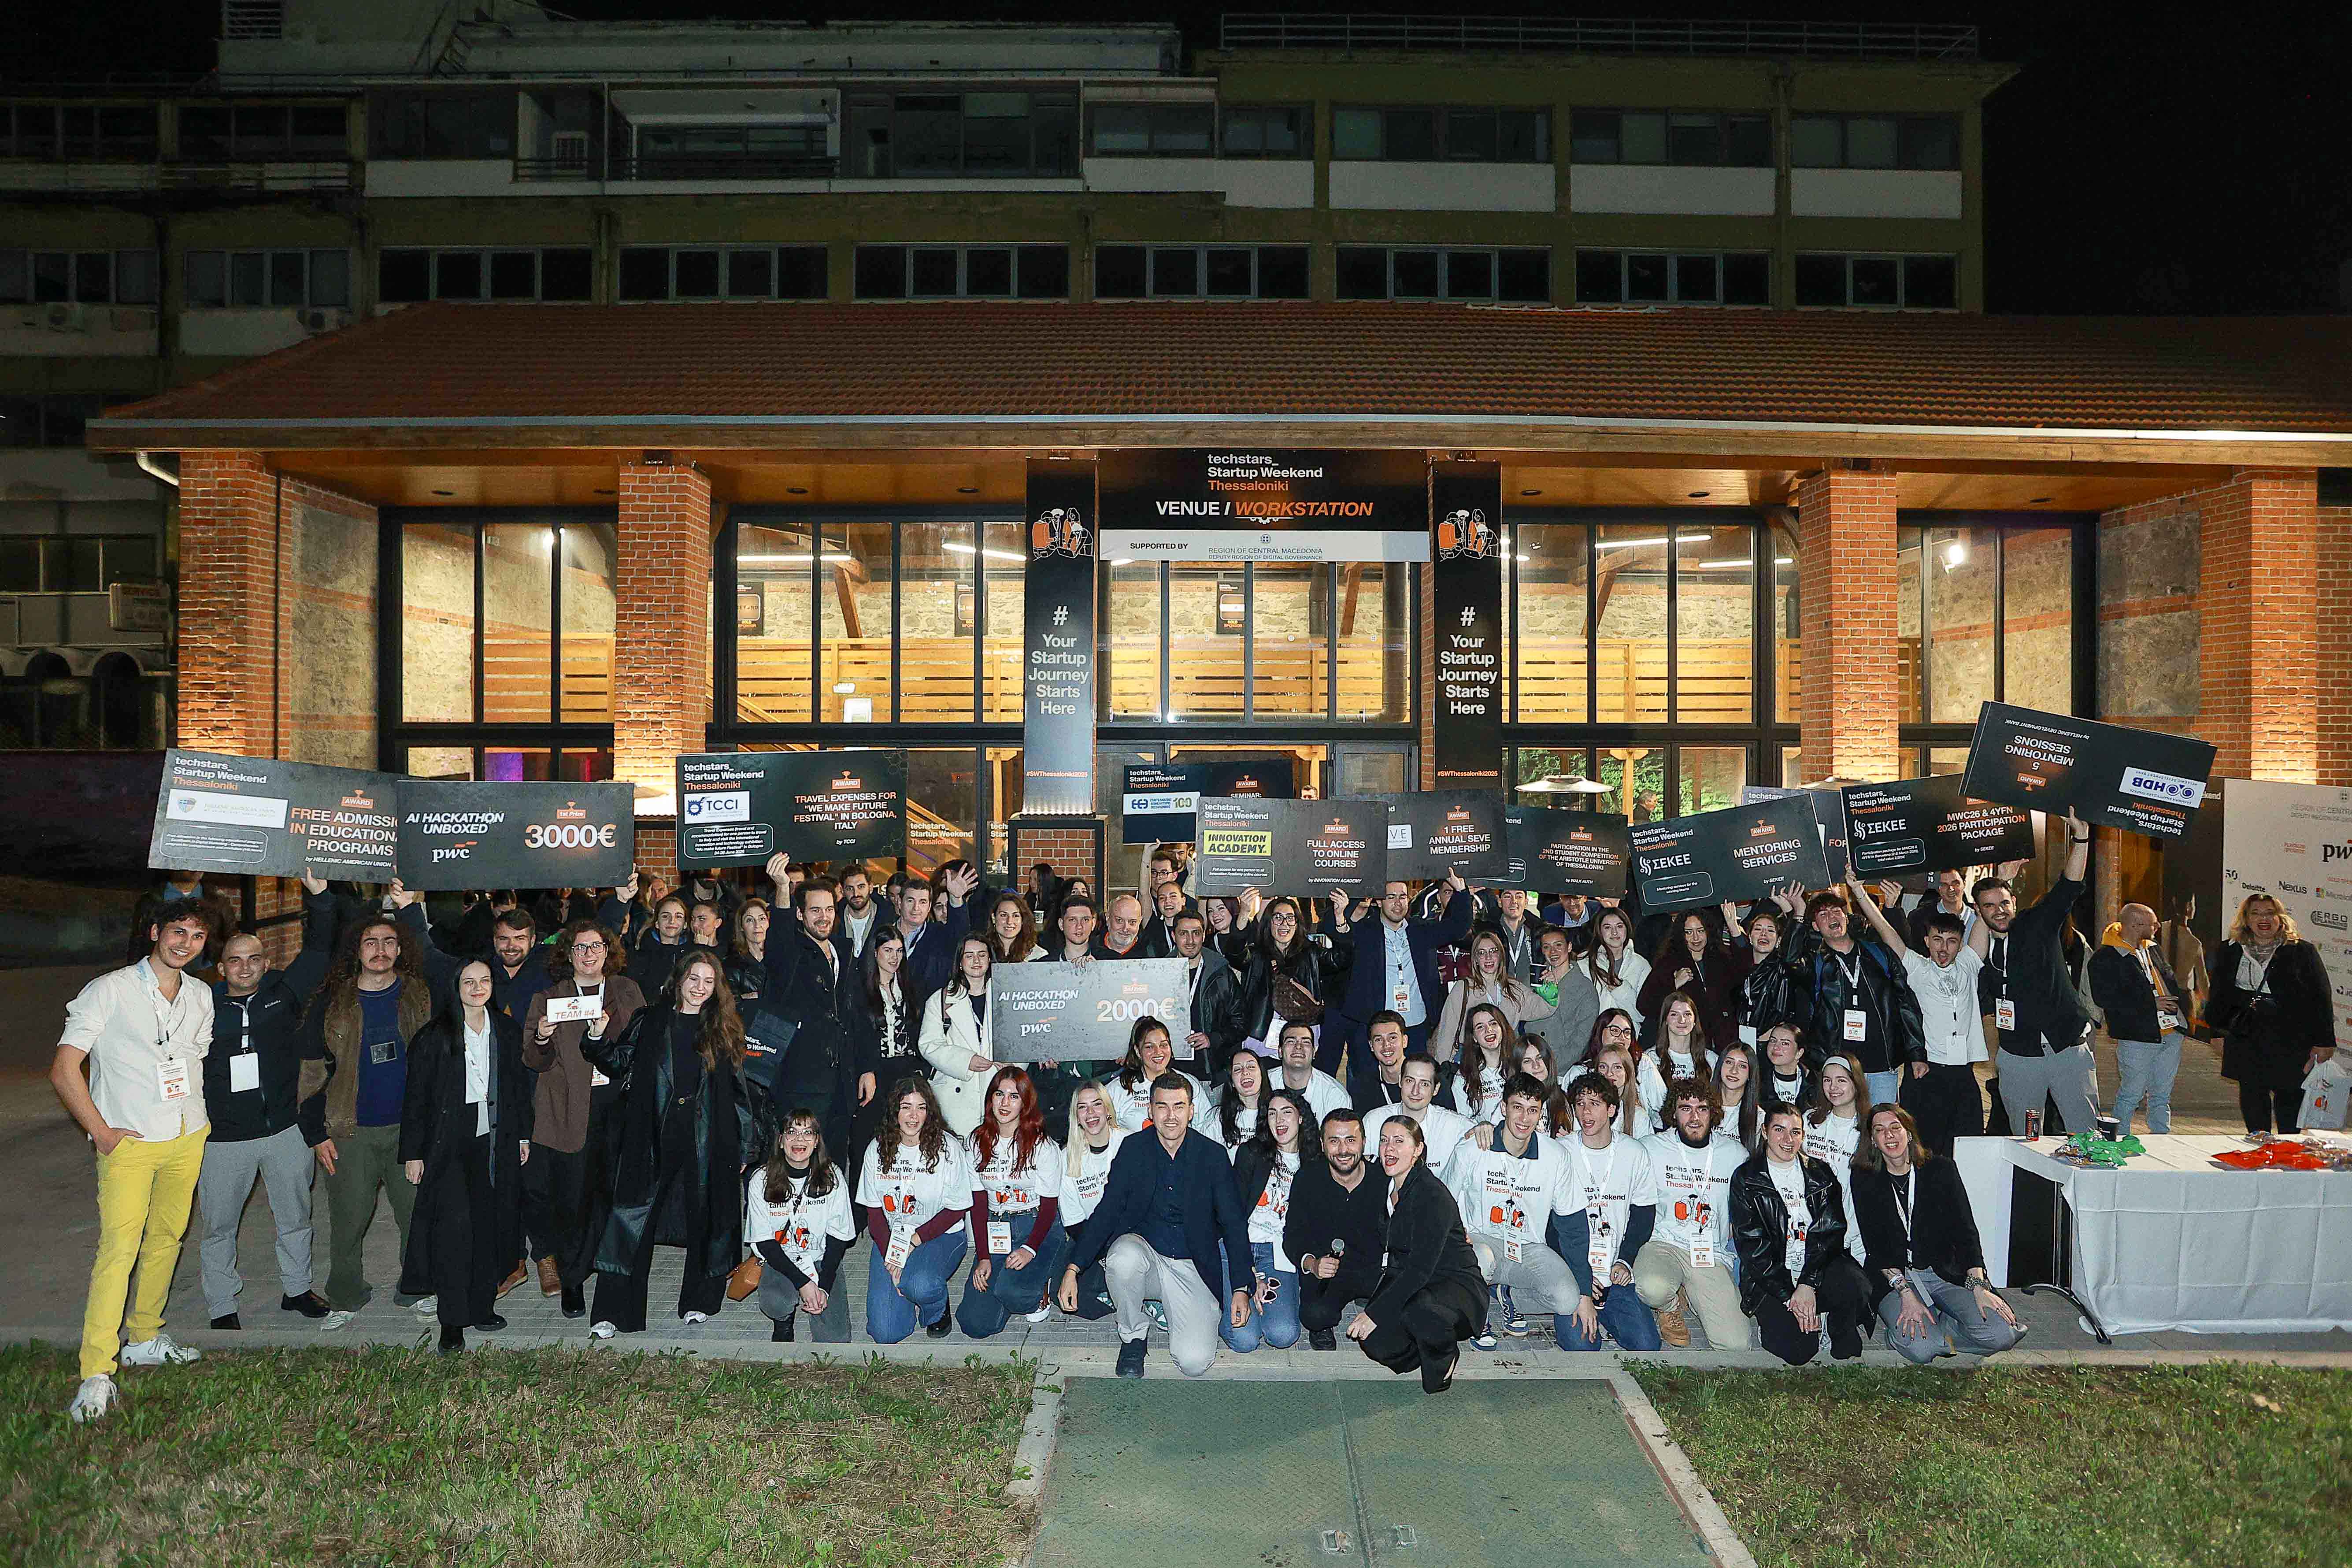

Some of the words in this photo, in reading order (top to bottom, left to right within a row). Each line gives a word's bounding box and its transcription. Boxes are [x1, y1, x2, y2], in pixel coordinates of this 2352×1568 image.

[1207, 454, 1279, 466] techstars_
[1207, 467, 1258, 479] Startup
[1261, 467, 1322, 478] Weekend
[1207, 480, 1289, 490] Thessaloniki
[1156, 502, 1220, 515] VENUE
[1224, 501, 1231, 515] /
[1235, 502, 1373, 516] WORKSTATION
[1053, 606, 1068, 626] #
[1460, 607, 1475, 626] #
[1042, 634, 1077, 648] Your
[1450, 635, 1485, 648] Your
[1031, 651, 1086, 667] Startup
[1440, 652, 1495, 667] Startup
[1029, 668, 1089, 684] Journey
[1438, 668, 1498, 684] Journey
[1036, 684, 1081, 698] Starts
[1445, 685, 1489, 698] Starts
[1041, 701, 1075, 715] Here
[1450, 701, 1485, 715] Here
[2019, 722, 2057, 734] DEVELOPMENT
[2057, 730, 2083, 739] HELLENIC
[2014, 735, 2071, 754] SESSIONS
[2005, 745, 2074, 766] MENTORING
[175, 757, 233, 771] techstars_
[684, 763, 733, 771] techstars_
[174, 767, 215, 780] Startup
[218, 771, 267, 784] Weekend
[722, 770, 764, 779] Weekend
[2020, 776, 2044, 785] AWARD
[173, 776, 239, 790] Thessaloniki
[684, 781, 740, 790] Thessaloniki
[2132, 777, 2166, 792] HDB
[795, 795, 829, 803] TRAVEL
[831, 793, 877, 802] EXPENSES
[1849, 790, 1887, 799] techstars_
[1877, 794, 1911, 804] Weekend
[707, 799, 737, 811] TCCI
[852, 802, 887, 810] FUTURE
[1204, 804, 1244, 812] techstars_
[1850, 805, 1894, 815] Thessaloniki
[2132, 802, 2185, 819] Thessaloniki
[291, 807, 331, 822] FREE
[406, 813, 420, 823] AI
[422, 812, 505, 823] HACKATHON
[794, 814, 838, 822] FESTIVAL"
[851, 811, 897, 819] BOLOGNA,
[1947, 810, 1980, 822] MWC26
[1990, 806, 2013, 815] 4YFN
[2107, 805, 2148, 821] Weekend
[1937, 823, 1957, 832] 2026
[1959, 815, 2026, 830] PARTICIPATION
[2135, 818, 2182, 836] techstars_
[2150, 814, 2185, 828] Startup
[289, 822, 306, 834] IN
[423, 824, 488, 834] UNBOXED
[1632, 827, 1669, 838] techstars_
[1961, 827, 2004, 840] PACKAGE
[525, 824, 617, 849] 3000€
[1429, 835, 1466, 845] ANNUAL
[1633, 837, 1659, 845] Startup
[1660, 829, 1693, 840] Weekend
[307, 839, 394, 856] PROGRAMS
[1330, 840, 1365, 849] ACCESS
[1430, 844, 1490, 854] MEMBERSHIP
[1635, 840, 1678, 852] Thessaloniki
[1733, 839, 1801, 858] MENTORING
[432, 849, 470, 862] pwc
[1742, 851, 1797, 869] SERVICES
[2242, 882, 2266, 893] Deloitte
[2279, 881, 2307, 894] Nexus
[2318, 911, 2348, 922] ERGO
[999, 992, 1010, 1001] AI
[1012, 990, 1078, 1000] HACKATHON
[1013, 1001, 1065, 1011] UNBOXED
[1096, 997, 1177, 1022] 2000€
[555, 1010, 582, 1019] TEAM
[1021, 1023, 1051, 1036] pwc
